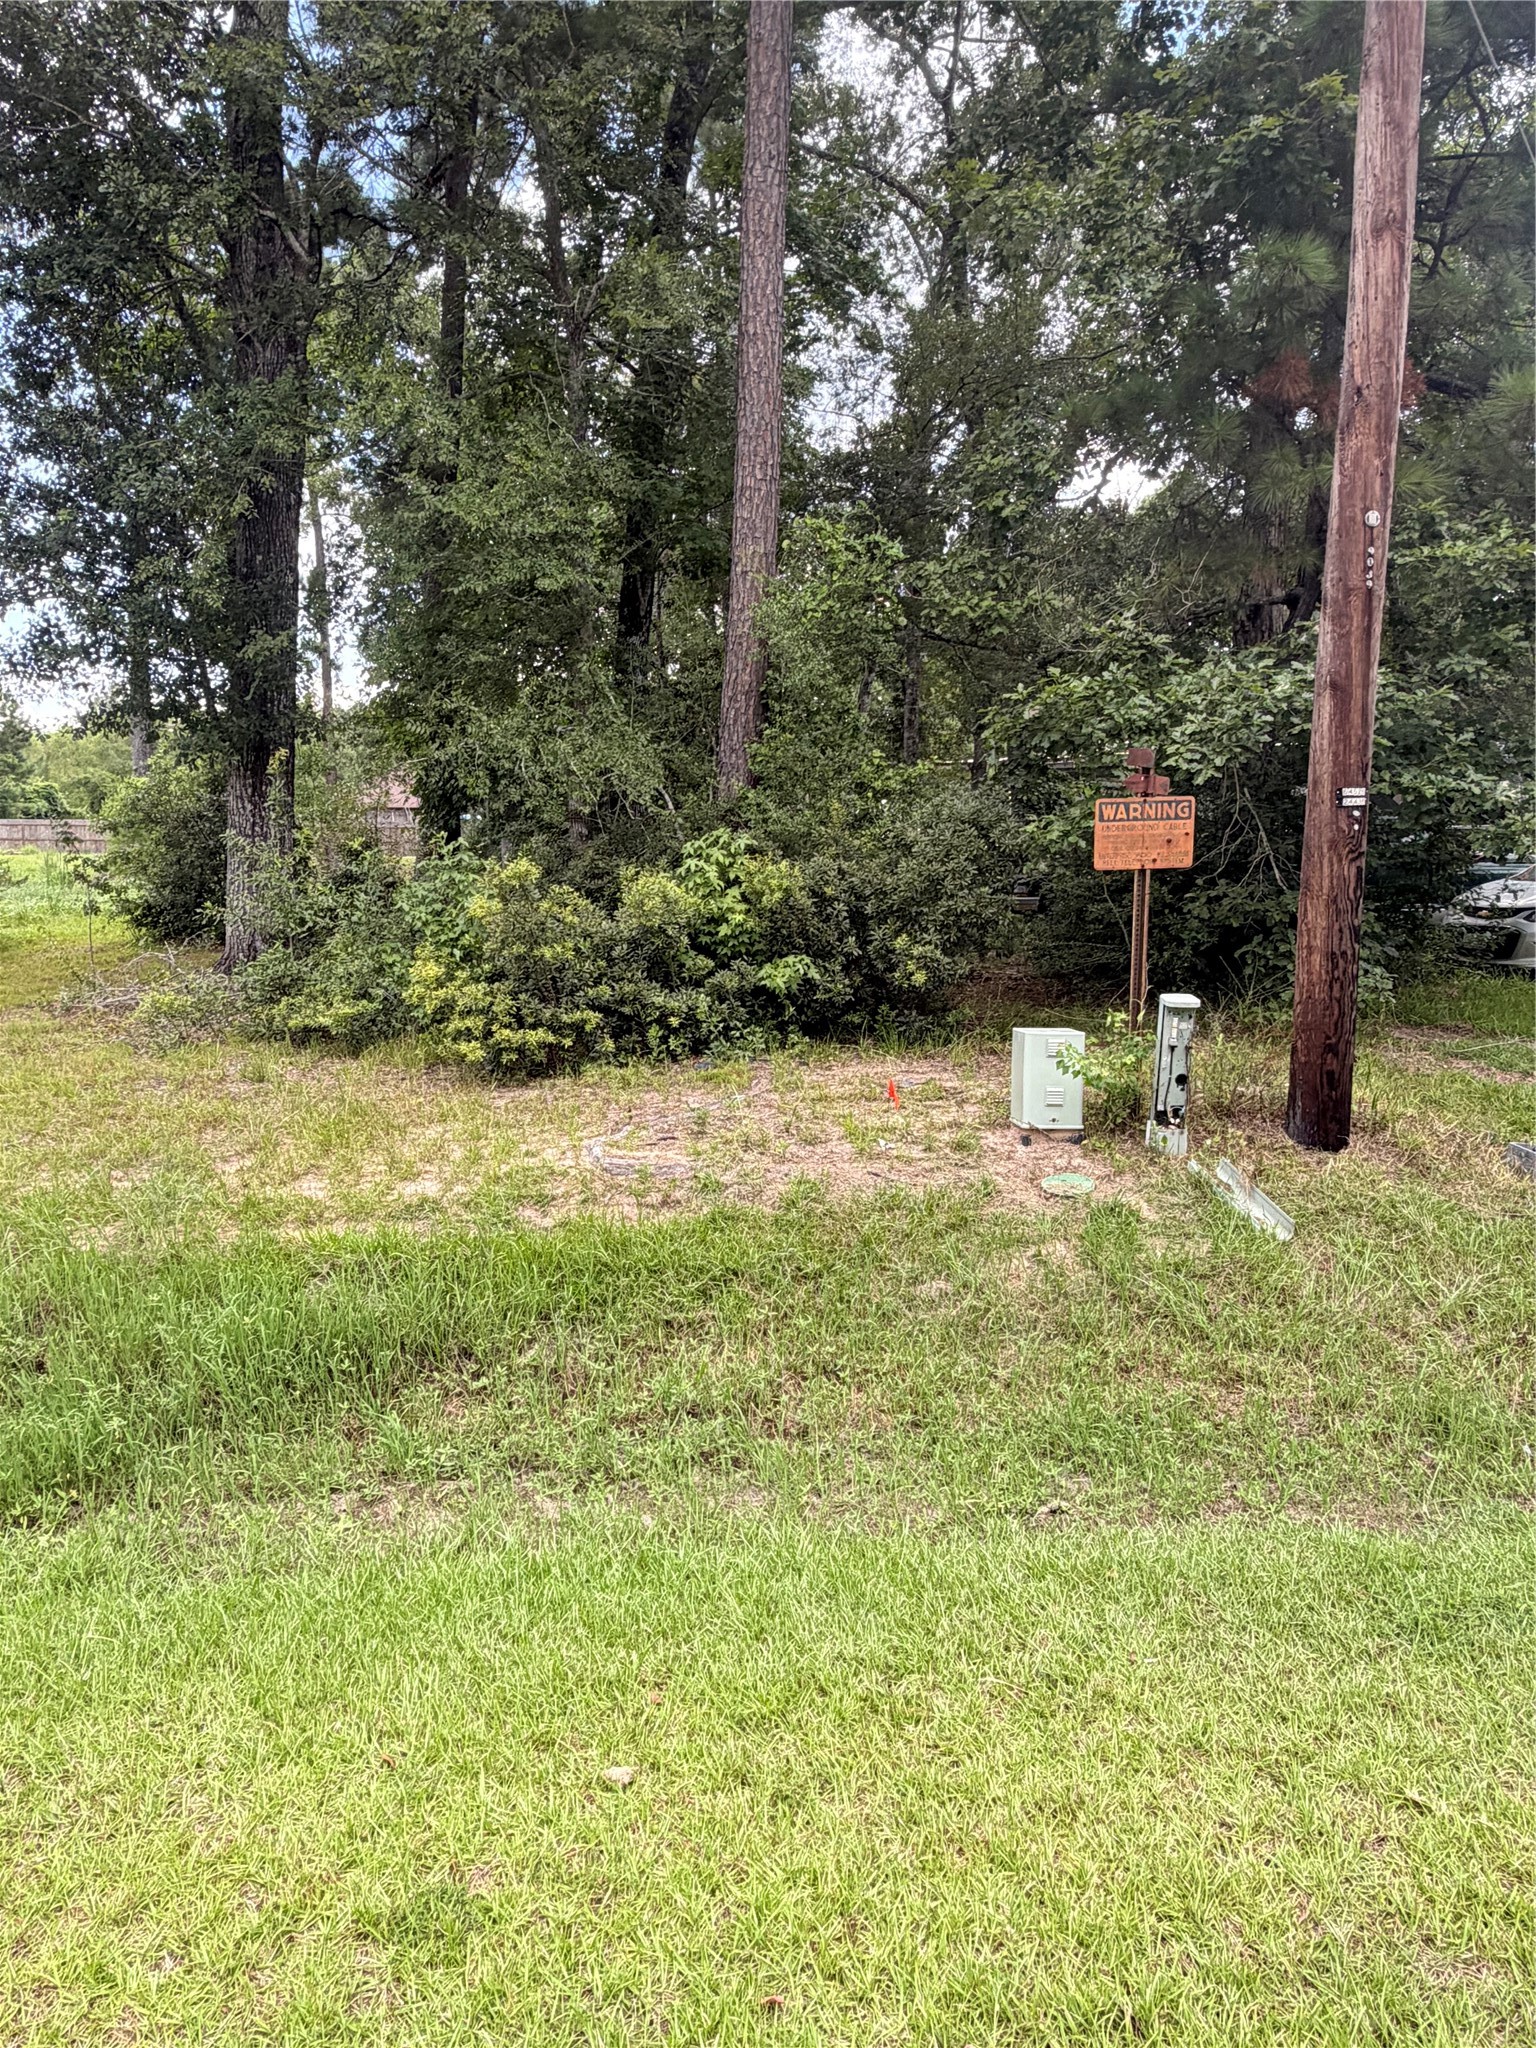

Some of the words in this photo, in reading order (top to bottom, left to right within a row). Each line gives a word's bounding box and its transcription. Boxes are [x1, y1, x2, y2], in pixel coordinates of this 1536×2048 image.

[1101, 802, 1190, 821] WARNING
[1101, 822, 1160, 832] UNDERGROUND
[1163, 822, 1187, 831] CABLE
